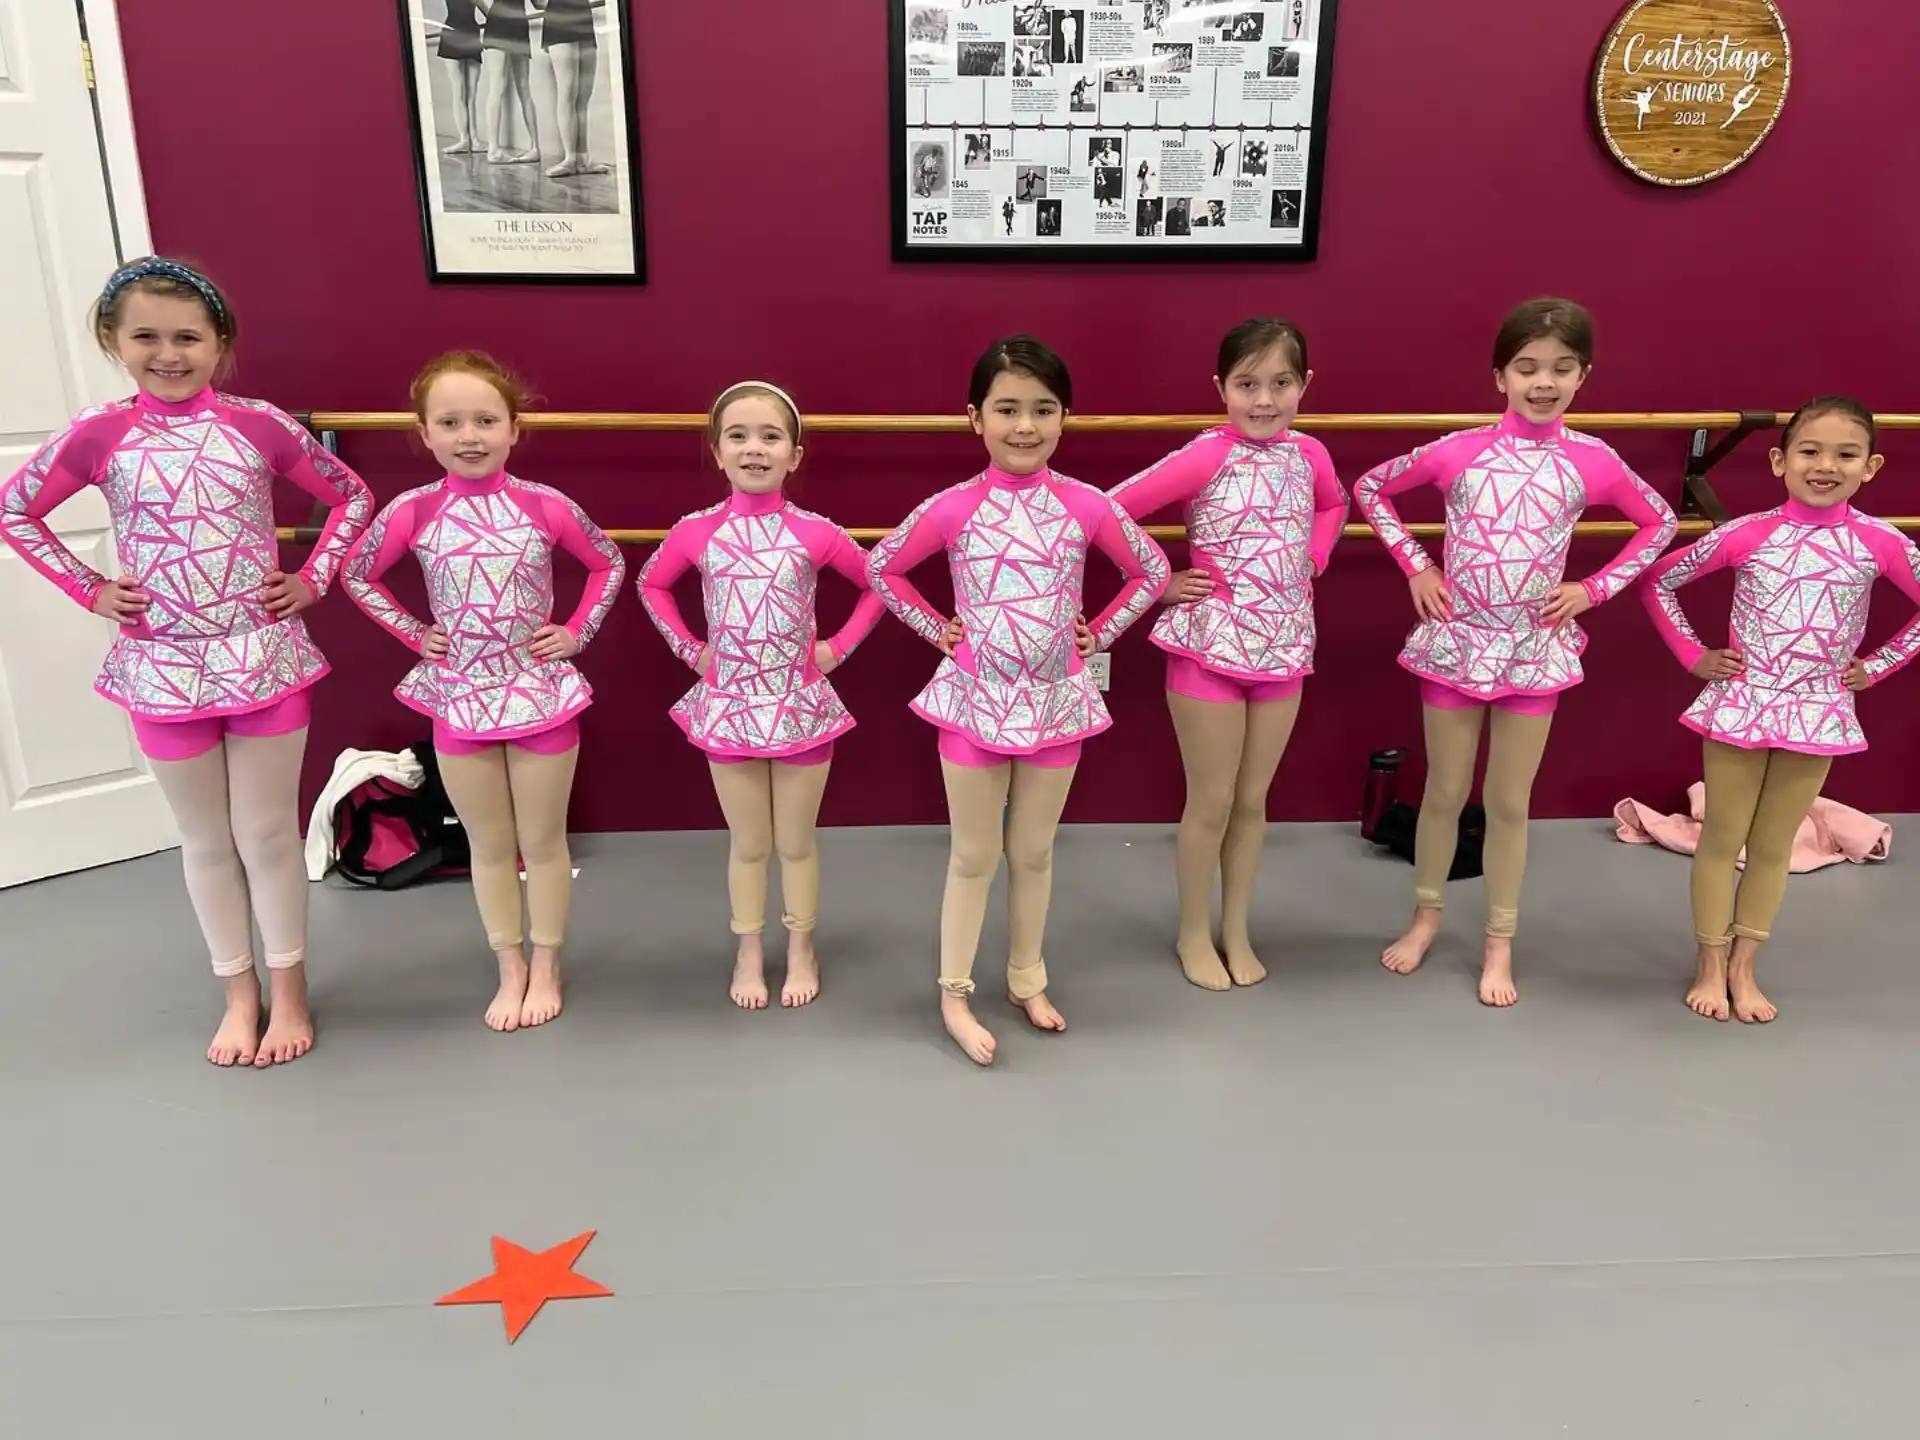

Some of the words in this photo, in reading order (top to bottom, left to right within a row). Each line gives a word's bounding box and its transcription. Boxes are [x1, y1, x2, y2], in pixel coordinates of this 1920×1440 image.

[1623, 33, 1777, 82] Centerstage
[1012, 79, 1033, 88] 1920s
[1663, 82, 1726, 103] SENIORS
[1673, 111, 1707, 126] 2021
[1273, 143, 1295, 152] 2010s
[992, 149, 1010, 157] 1915
[1050, 167, 1070, 175] 1940s
[951, 180, 969, 188] 1845
[1232, 180, 1253, 188] 1990s
[912, 211, 948, 225] TAP
[1095, 212, 1127, 220] 1950-70s
[494, 219, 521, 233] THE
[524, 219, 573, 233] LESSON
[912, 225, 948, 235] NOTES
